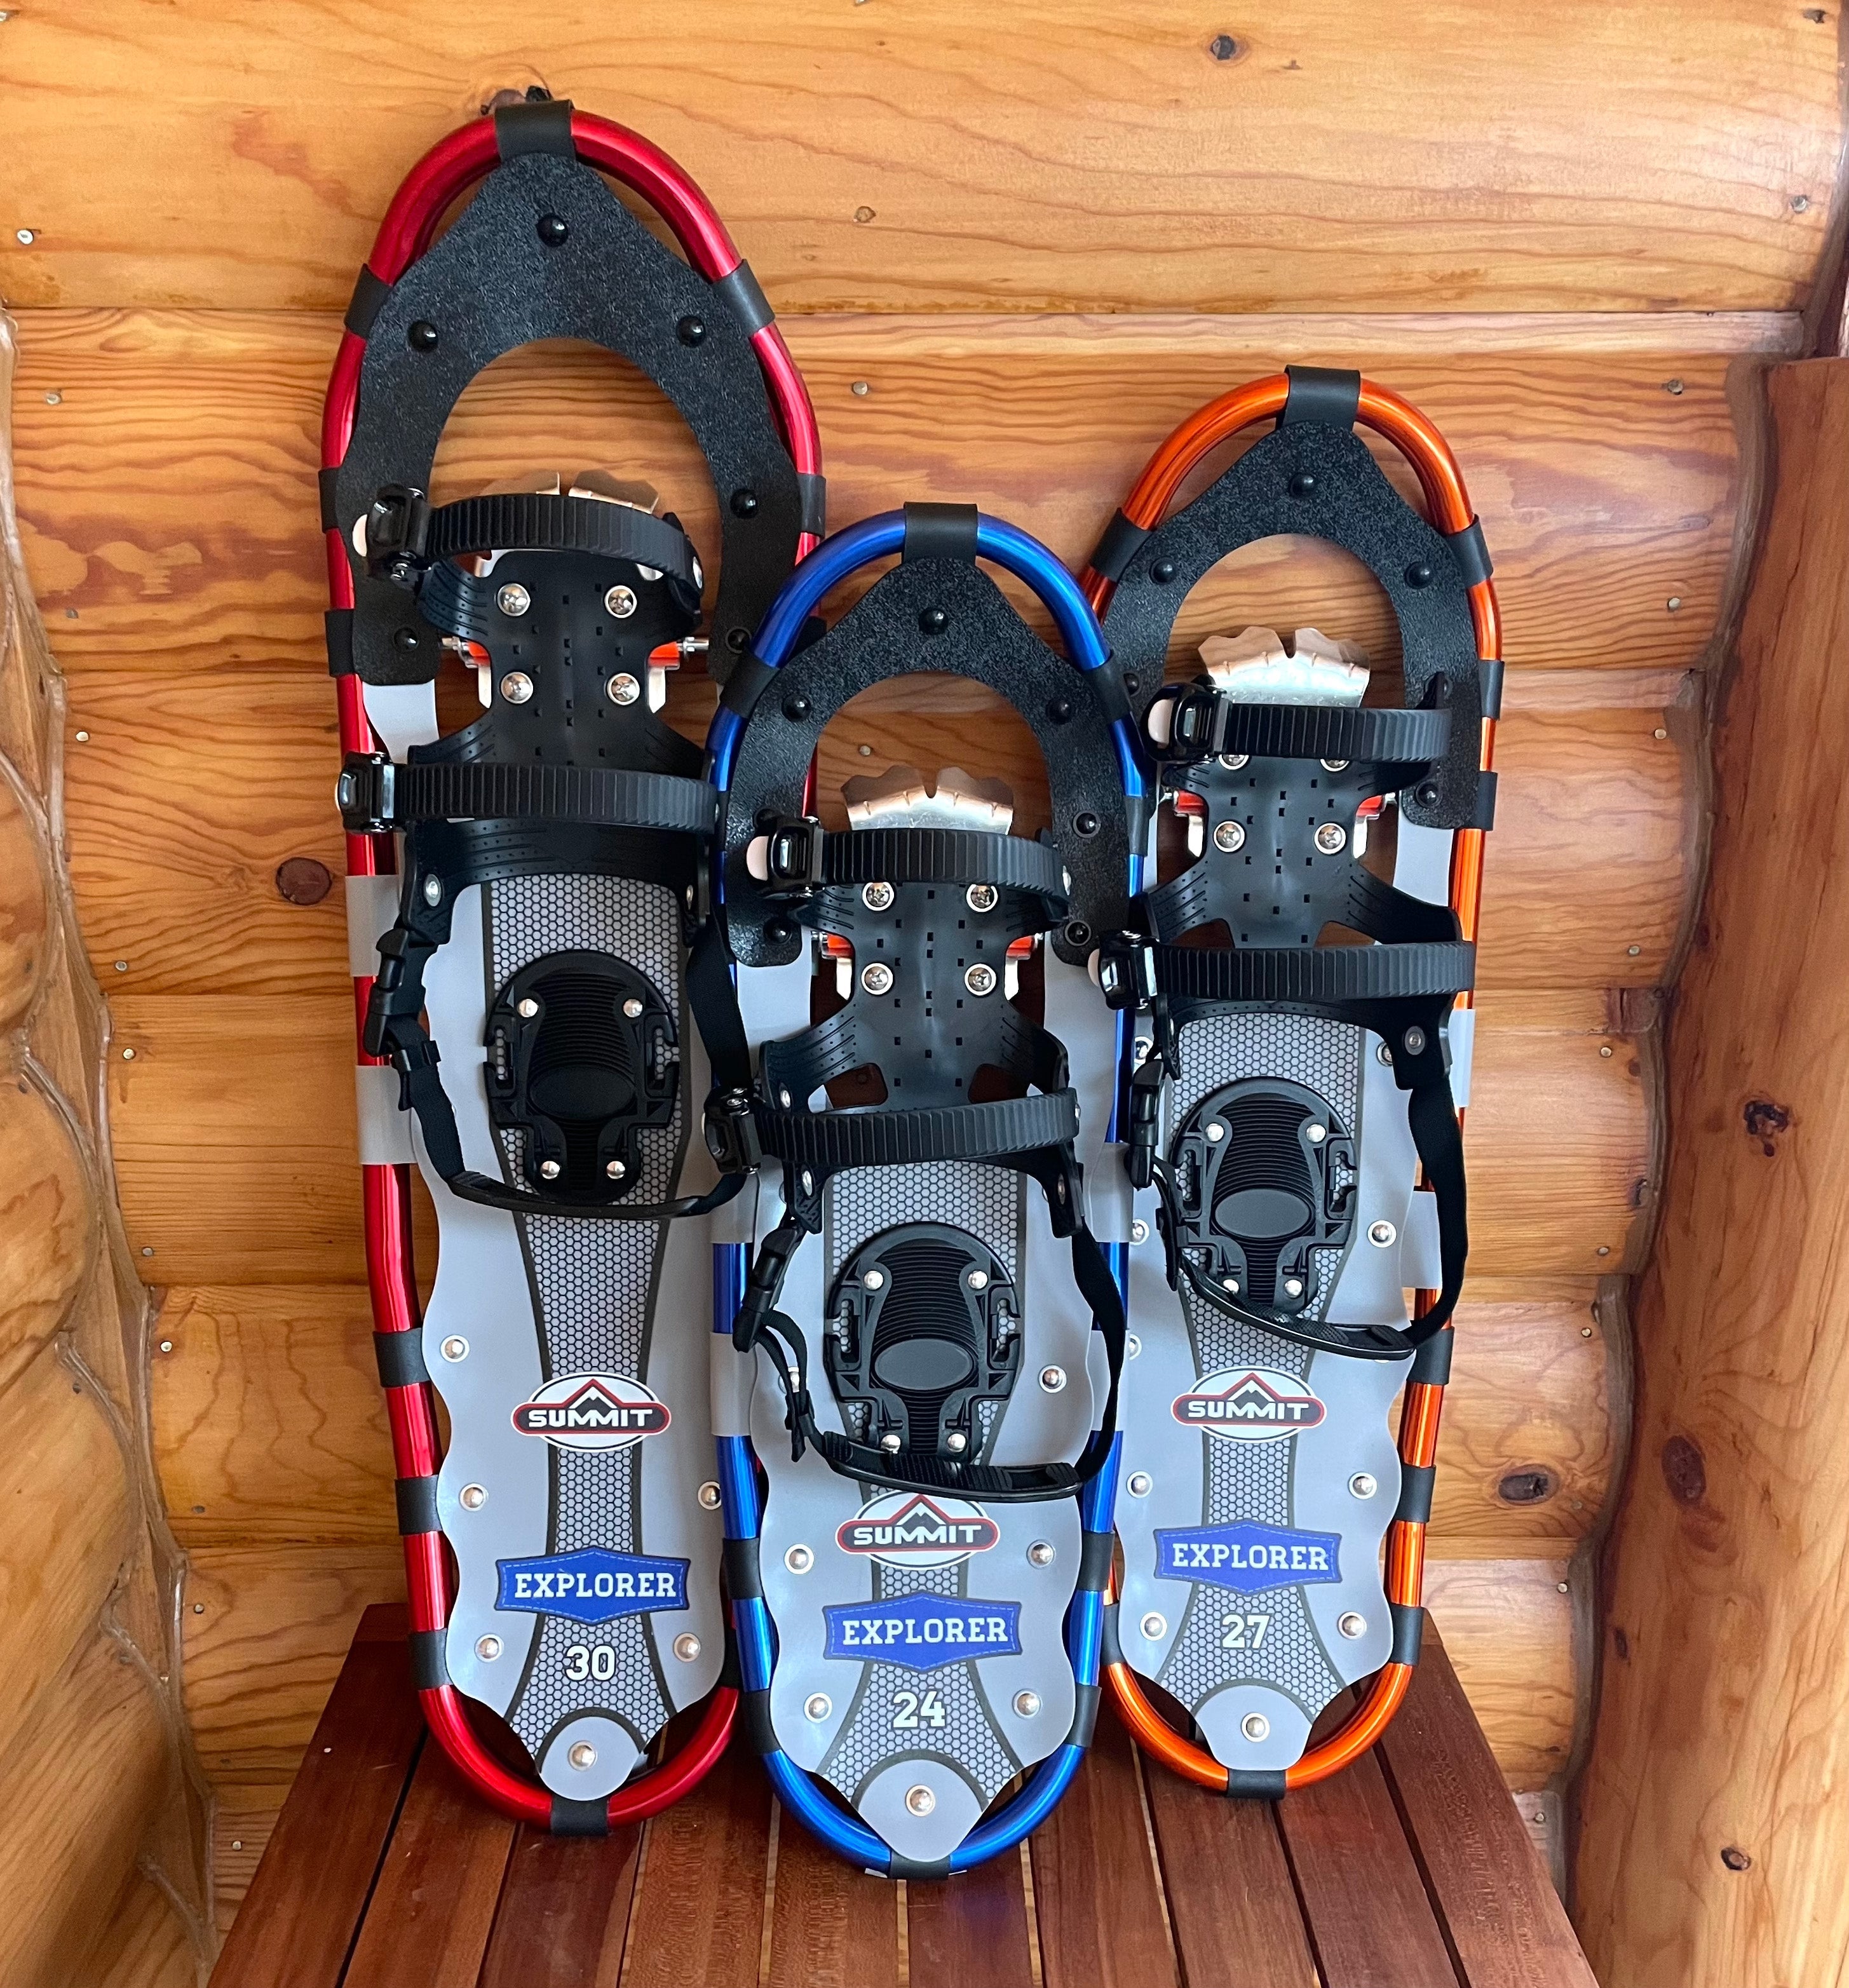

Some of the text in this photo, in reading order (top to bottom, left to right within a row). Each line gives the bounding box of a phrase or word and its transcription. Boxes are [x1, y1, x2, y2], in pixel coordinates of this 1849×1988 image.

[528, 1409, 653, 1428] SUMMIT
[1187, 1400, 1310, 1420] SUMMIT
[853, 1525, 982, 1545] SUMMIT
[1172, 1543, 1329, 1571] EXPLORER
[514, 1572, 677, 1599] EXPLORER
[842, 1616, 1008, 1646] EXPLORER
[1222, 1614, 1270, 1649] 27
[565, 1645, 616, 1681] 30
[893, 1691, 945, 1728] 24
